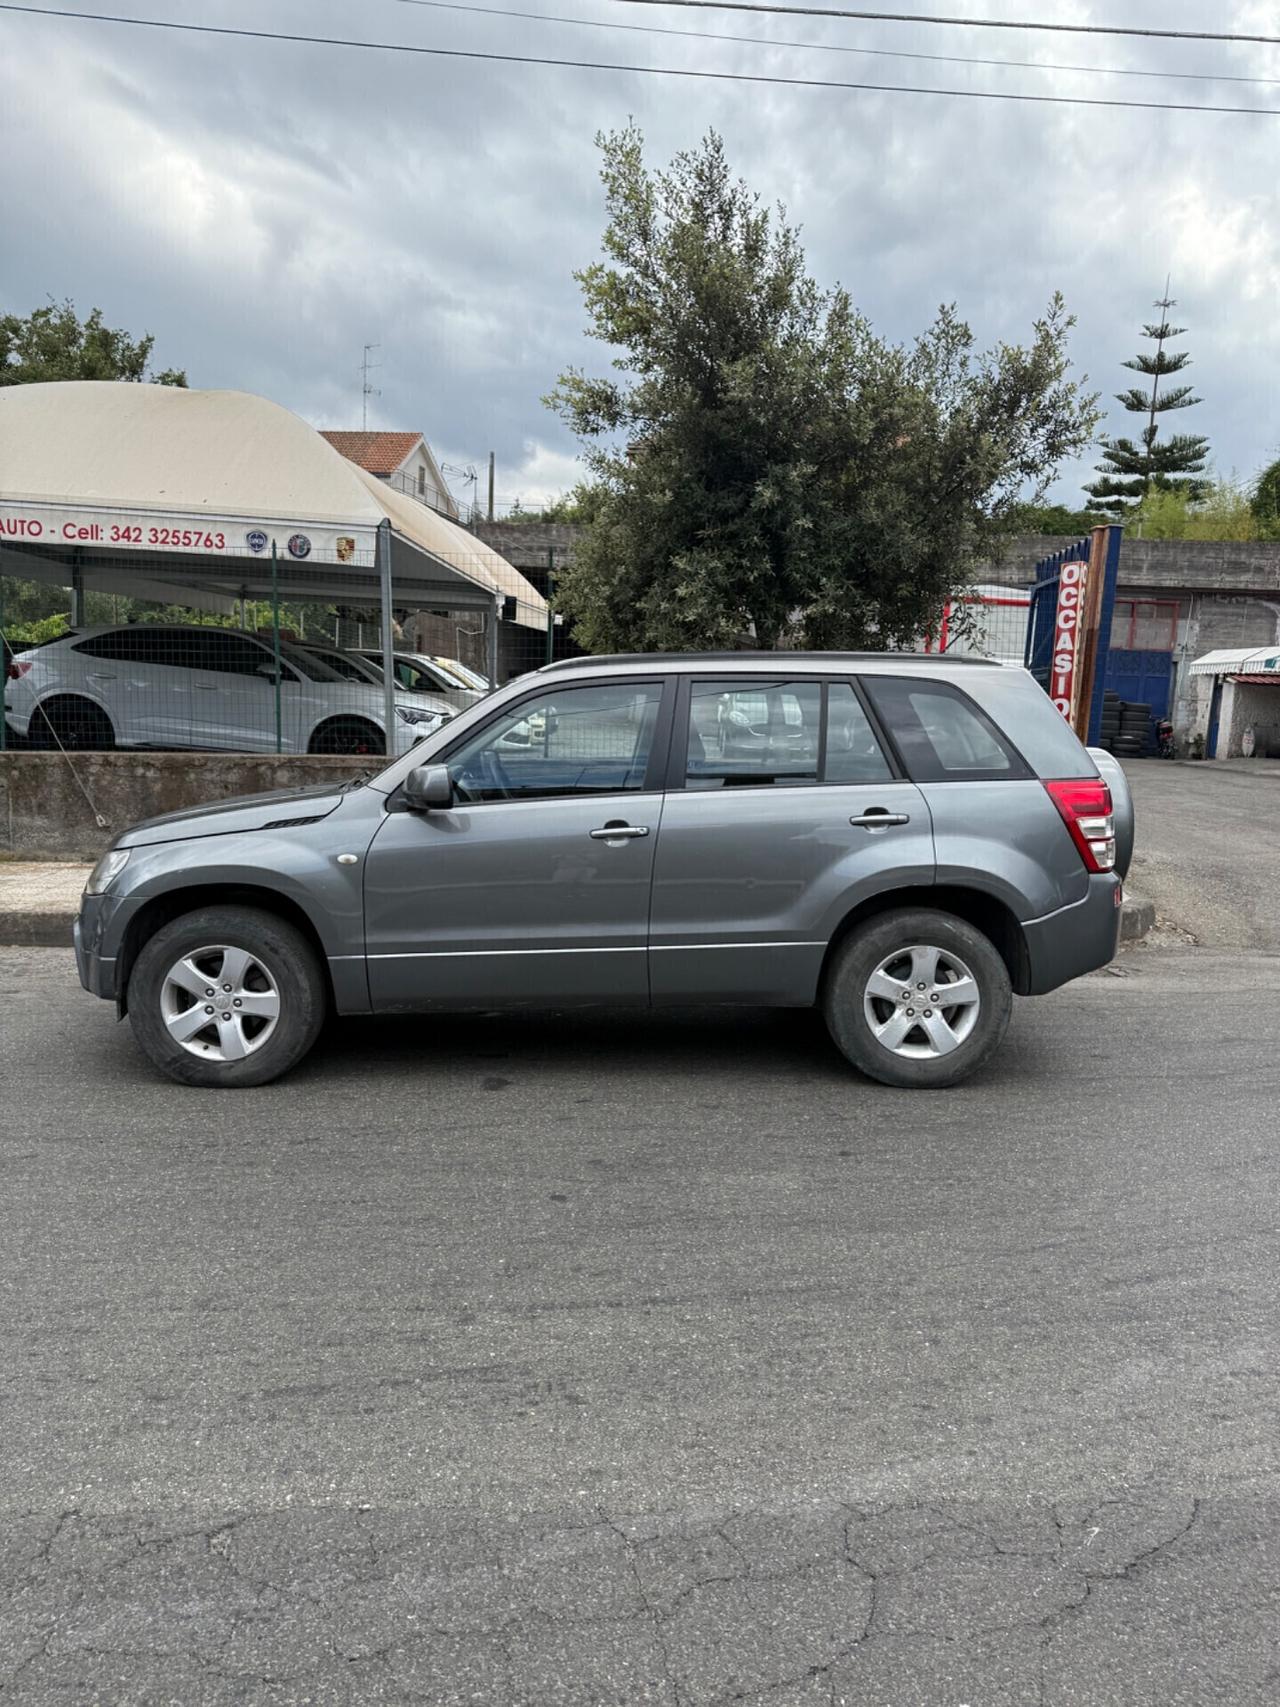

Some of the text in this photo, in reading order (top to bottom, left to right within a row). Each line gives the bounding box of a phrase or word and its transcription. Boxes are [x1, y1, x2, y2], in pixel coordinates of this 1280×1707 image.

[62, 522, 104, 541] Cell:
[110, 525, 142, 543] 342
[148, 527, 225, 549] 3255763
